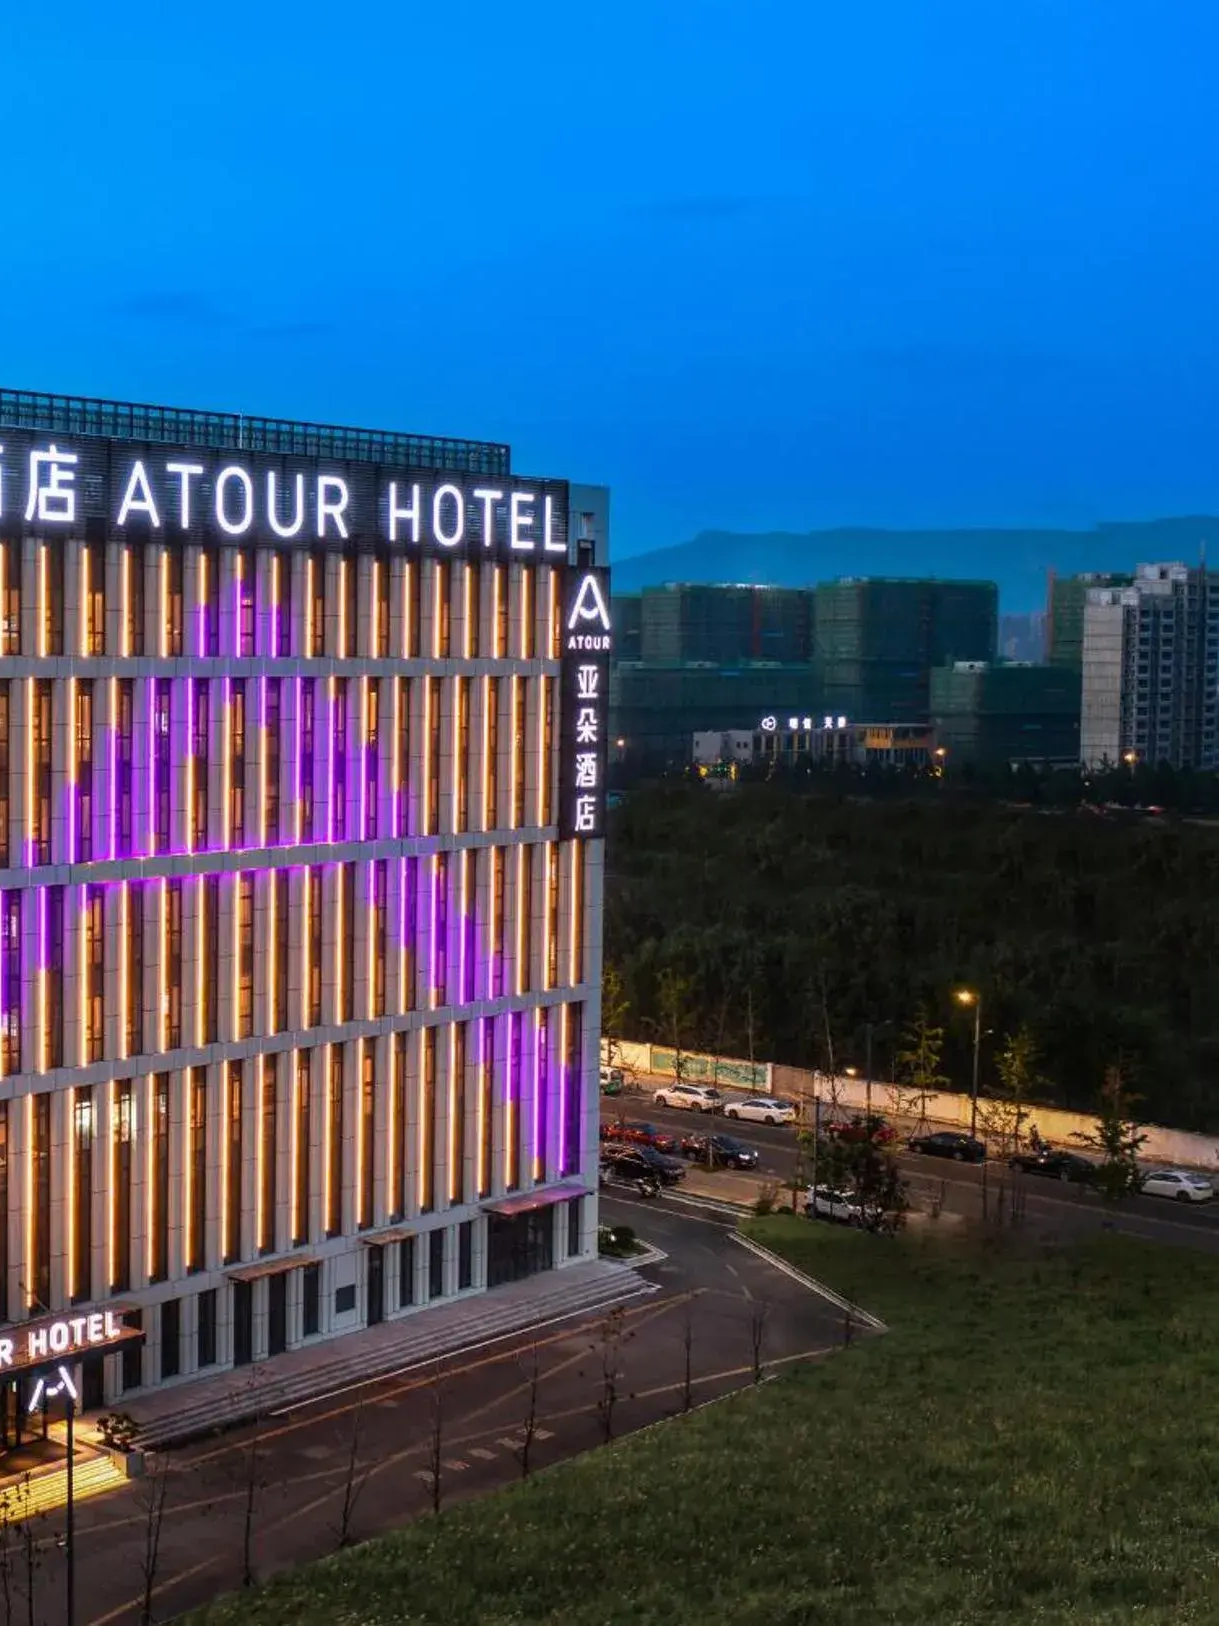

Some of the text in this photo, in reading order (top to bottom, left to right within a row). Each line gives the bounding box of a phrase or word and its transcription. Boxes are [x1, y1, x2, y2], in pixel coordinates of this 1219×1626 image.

[116, 460, 349, 539] ATOUR
[388, 481, 567, 551] HOTEL
[568, 634, 611, 650] ATOUR
[574, 664, 599, 832] 亚朵酒店
[28, 1311, 121, 1359] HOTEL
